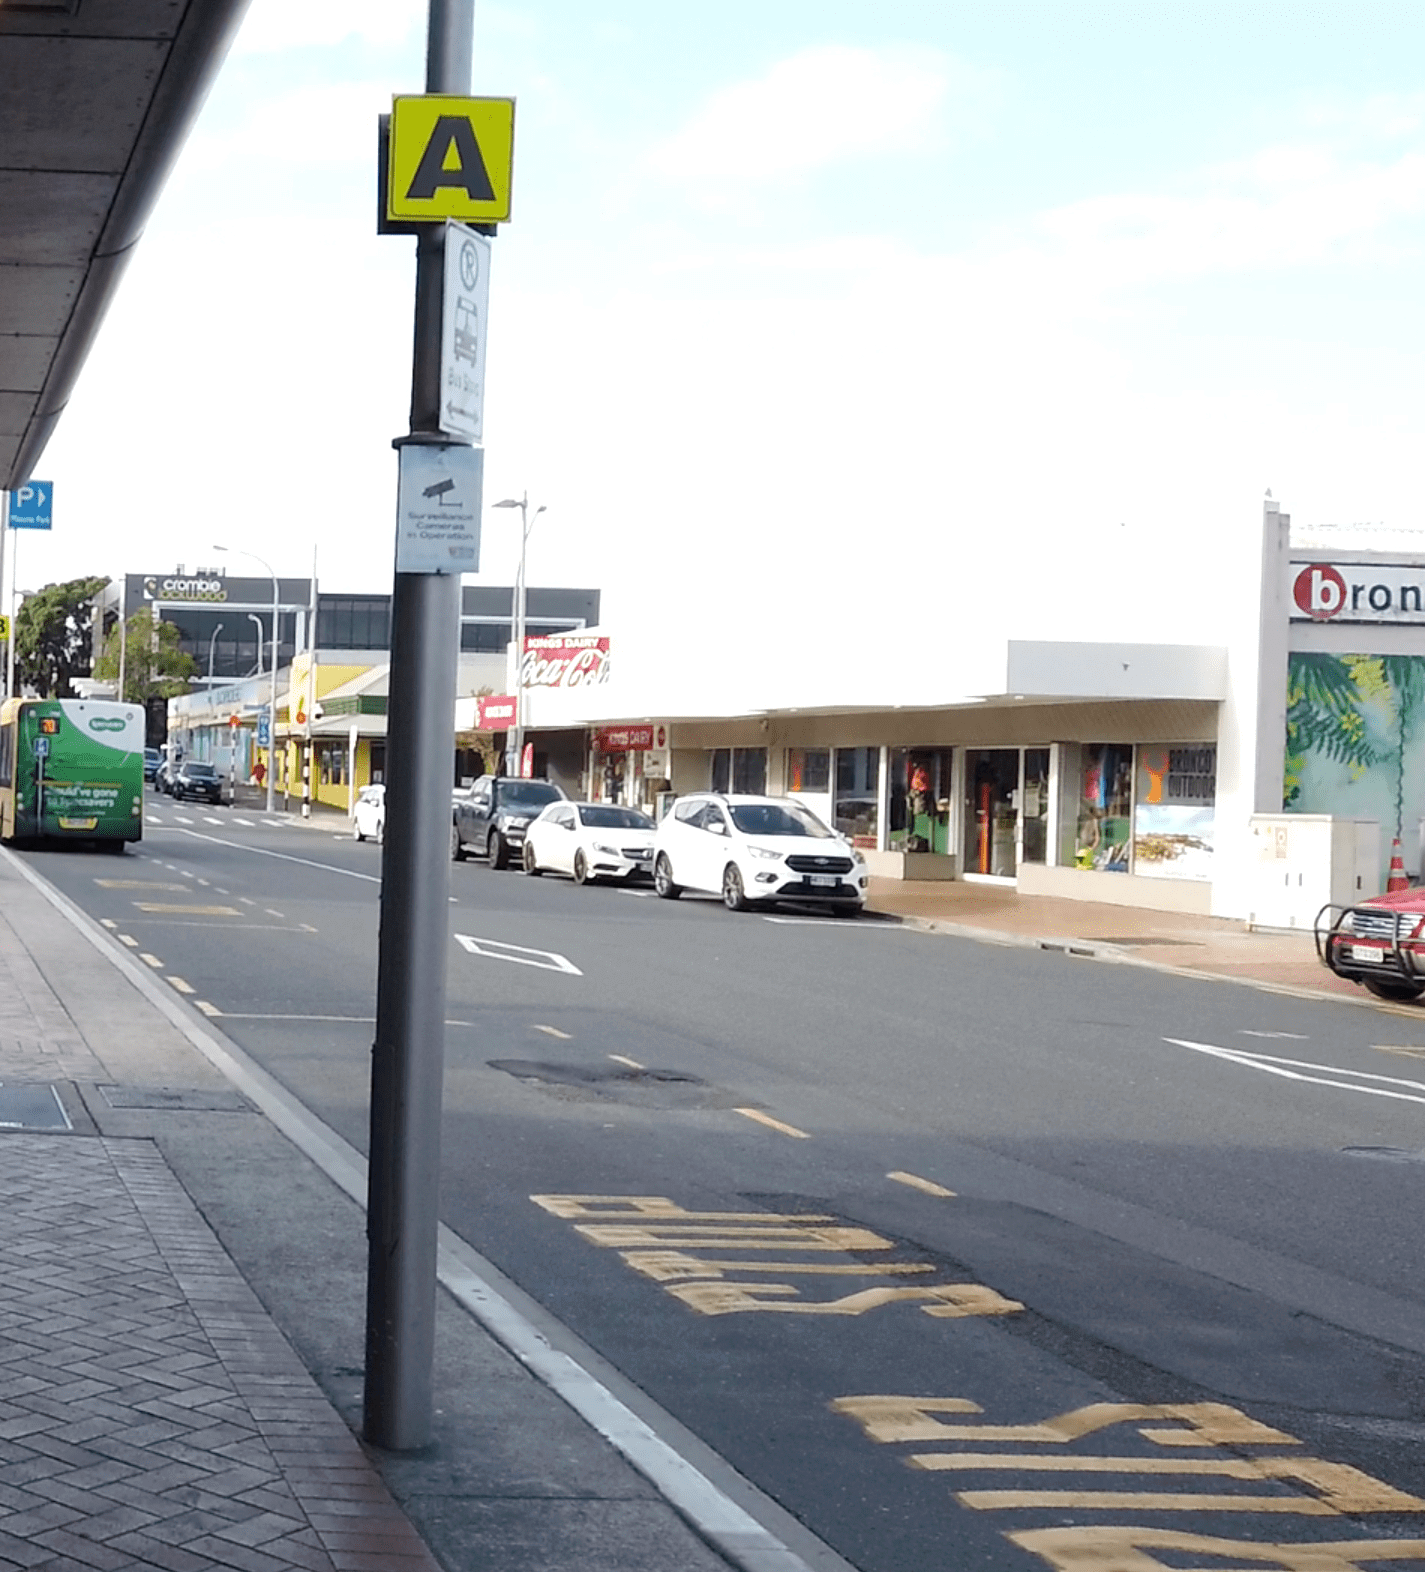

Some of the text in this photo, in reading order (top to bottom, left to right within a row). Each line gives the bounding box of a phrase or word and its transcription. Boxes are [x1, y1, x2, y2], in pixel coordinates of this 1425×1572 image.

[405, 115, 496, 201] A
[416, 521, 465, 530] Cameras
[419, 531, 474, 540] Operation
[162, 578, 221, 592] crombie
[528, 638, 599, 648] KINGS DAIRY
